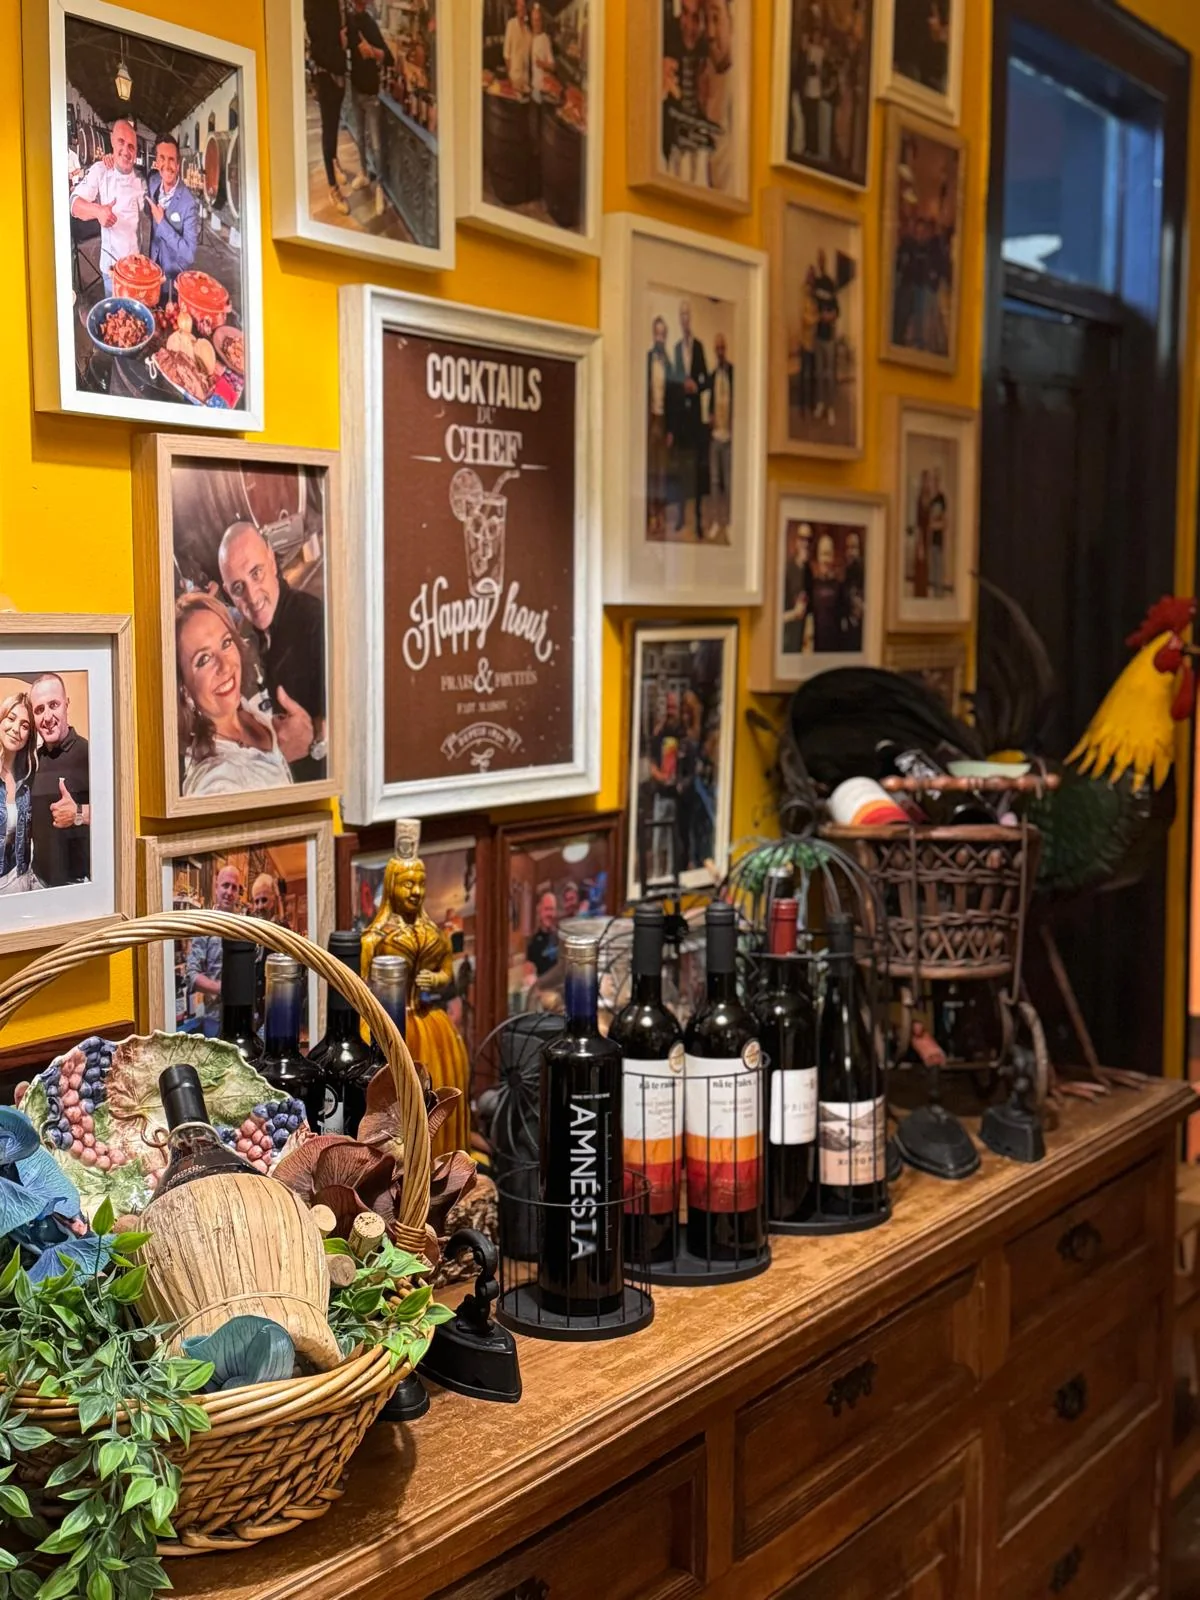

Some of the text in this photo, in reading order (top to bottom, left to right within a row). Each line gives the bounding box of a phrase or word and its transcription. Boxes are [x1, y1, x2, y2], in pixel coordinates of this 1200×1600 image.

[426, 352, 542, 412] COCKTAILS
[444, 423, 523, 467] CHEF
[402, 575, 553, 671] Happy hour
[474, 656, 494, 695] &
[569, 1103, 602, 1261] AMNÉSIA
